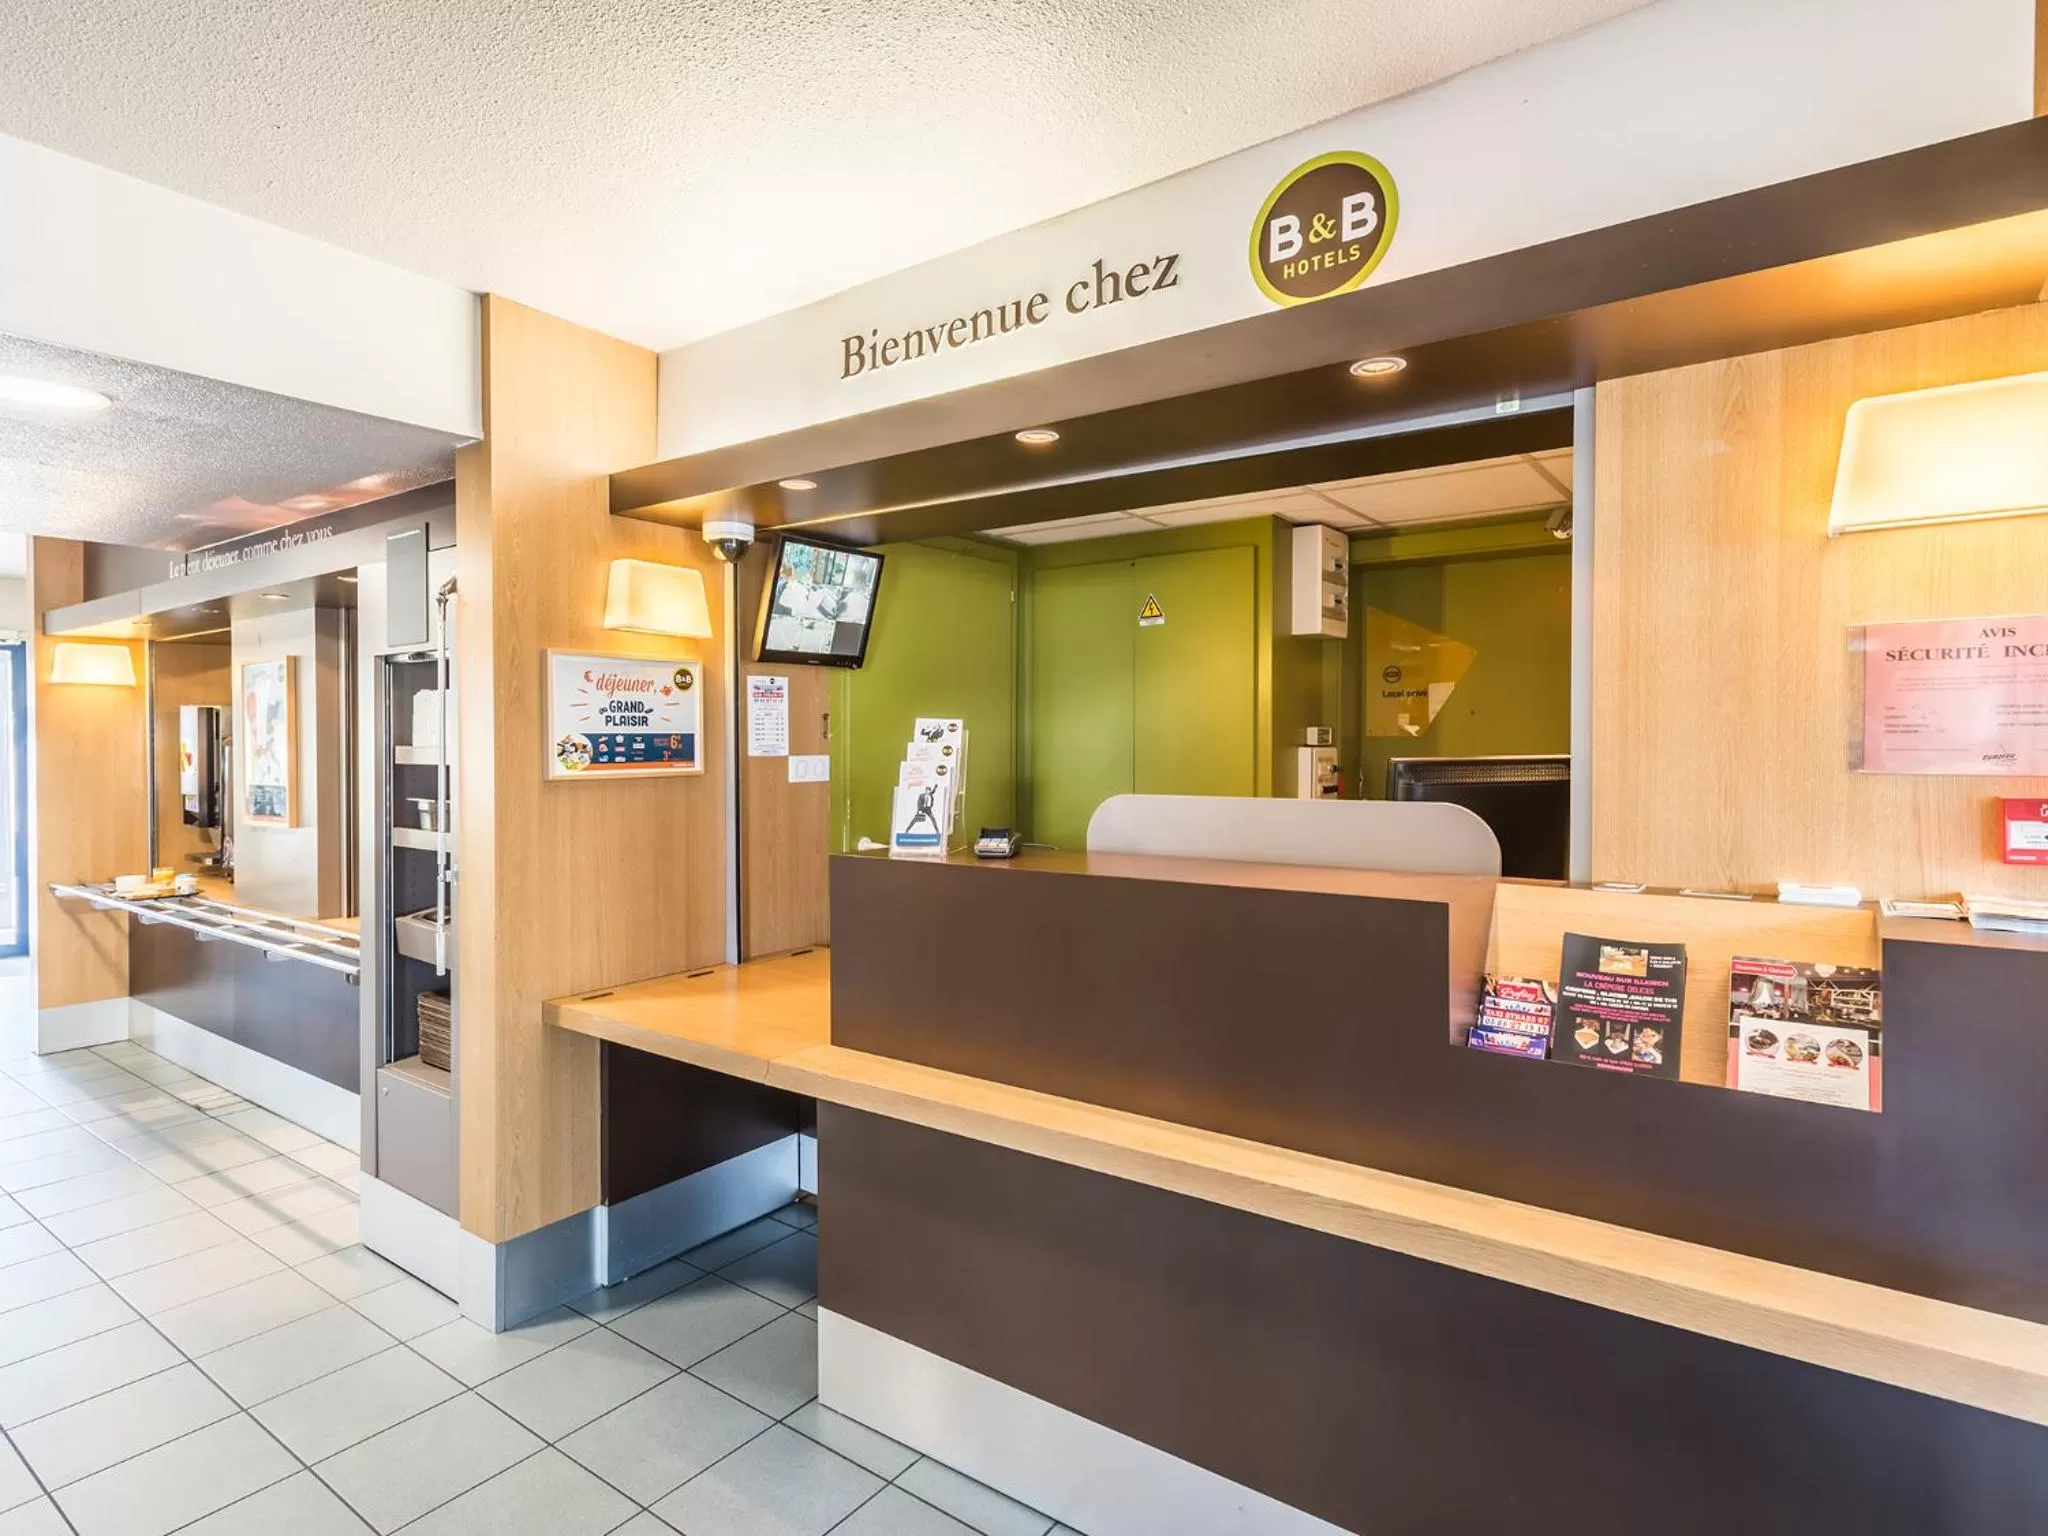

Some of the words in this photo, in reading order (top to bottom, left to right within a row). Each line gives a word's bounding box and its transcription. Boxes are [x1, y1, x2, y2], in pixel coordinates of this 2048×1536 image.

[1268, 190, 1379, 264] B&B
[1282, 244, 1361, 279] HOTELS
[839, 291, 1050, 381] Bienvenue
[1064, 252, 1181, 314] chez
[169, 560, 179, 579] Le
[242, 540, 279, 560] comme
[279, 529, 304, 552] chez
[305, 526, 334, 545] vous
[1979, 627, 2017, 638] AVIS
[1884, 643, 1992, 662] SÉCURITÉ
[608, 699, 645, 714] GRAND
[604, 714, 650, 728] PLAISIR
[1485, 1008, 1504, 1018] TAXI
